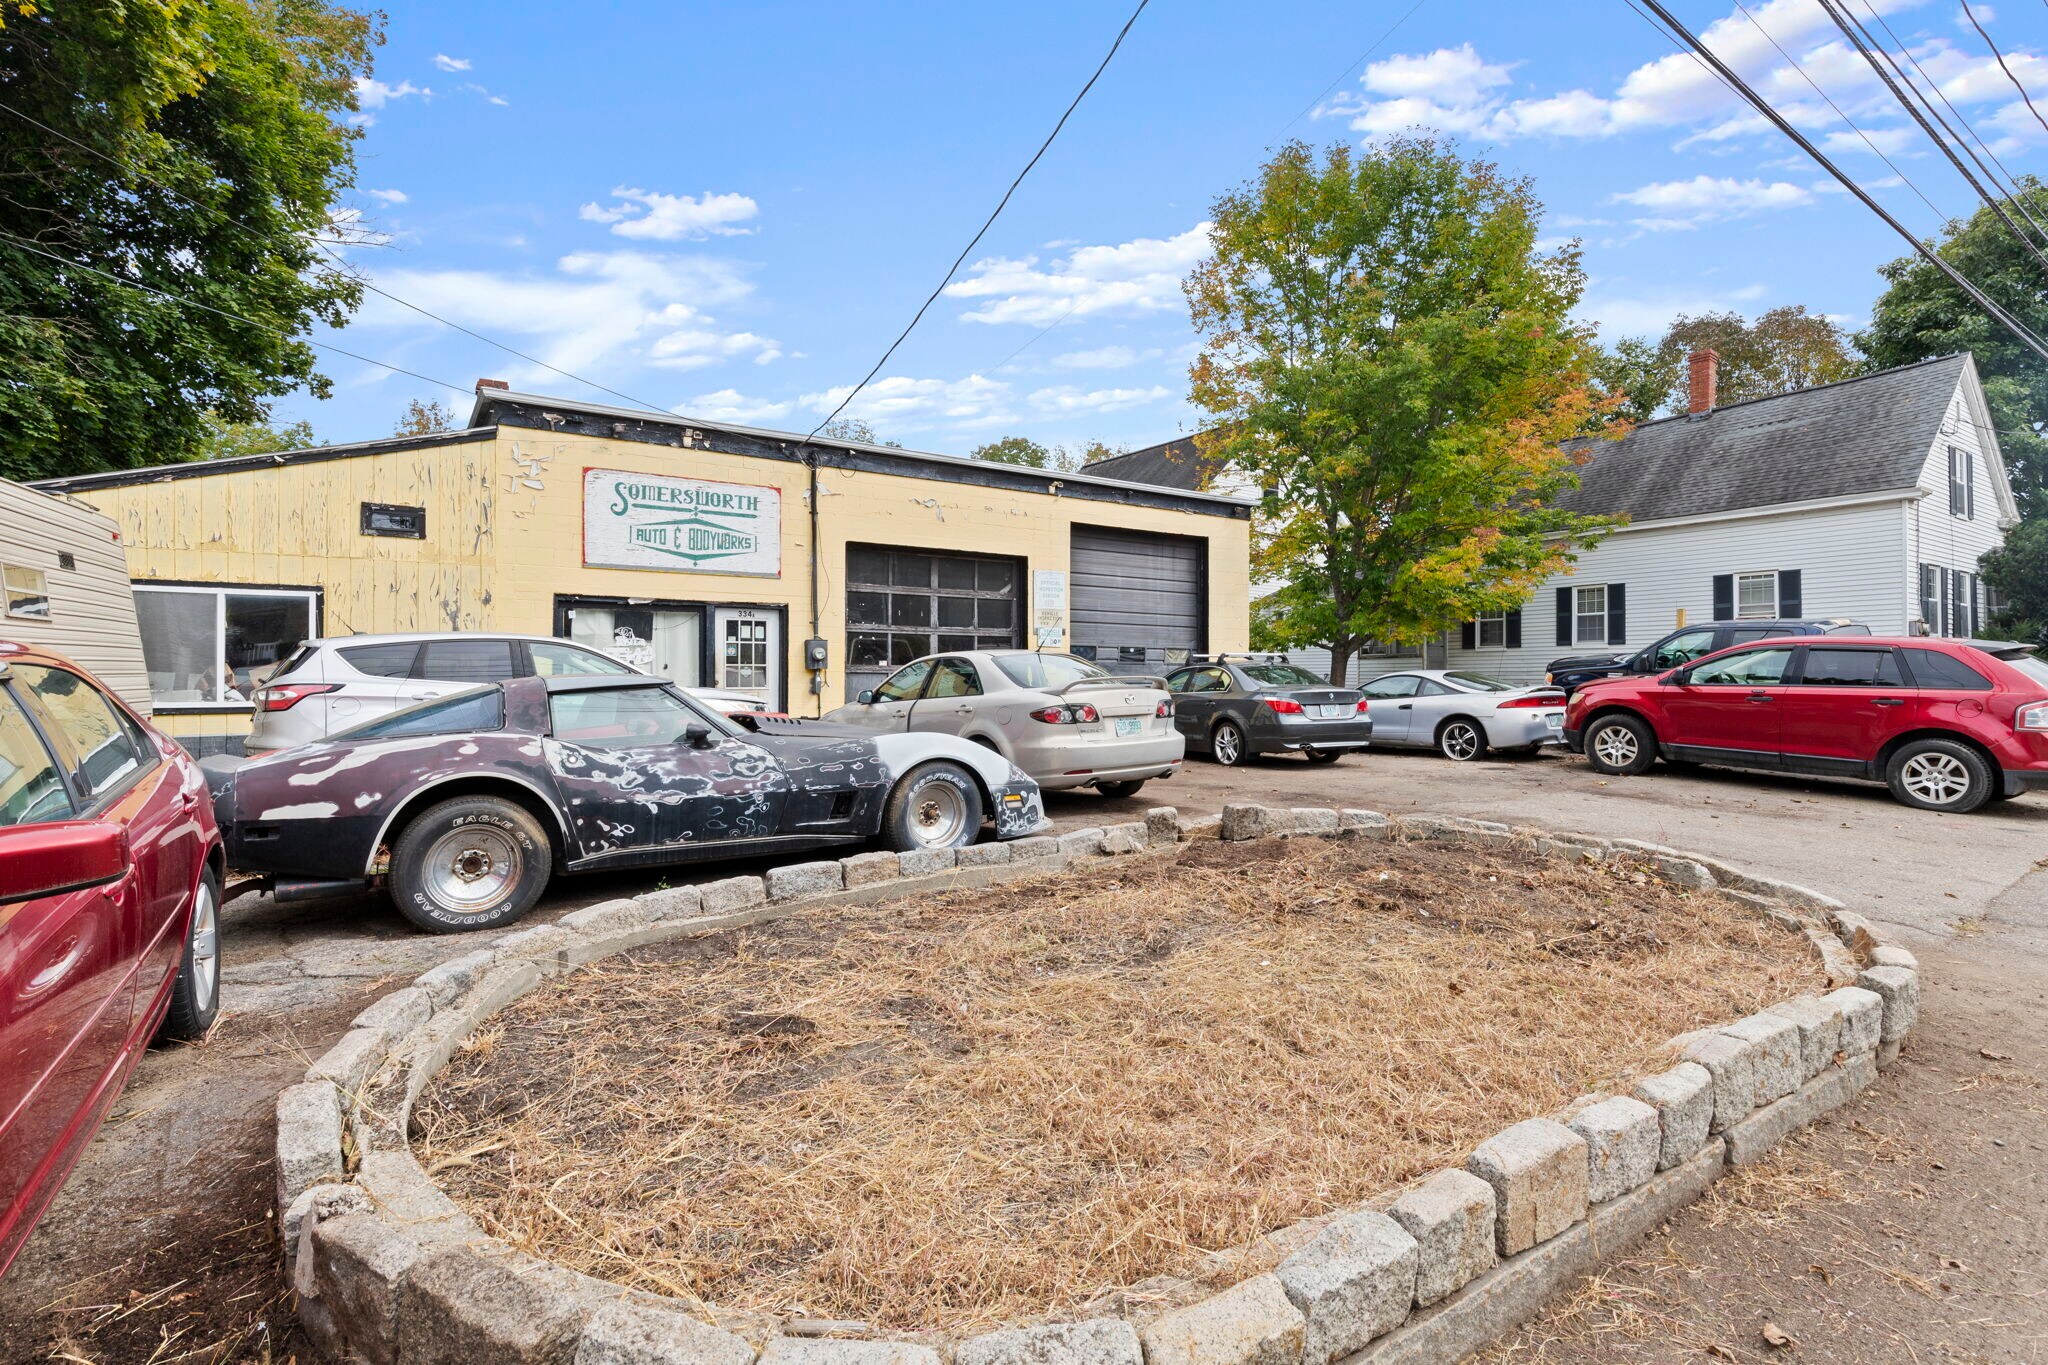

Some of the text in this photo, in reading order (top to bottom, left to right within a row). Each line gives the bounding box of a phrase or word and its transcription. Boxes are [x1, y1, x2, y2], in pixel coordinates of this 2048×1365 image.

[610, 481, 759, 516] SOMERSWORTH
[636, 528, 667, 546] AUTO
[688, 527, 752, 550] BODYWORKS
[908, 773, 966, 800] GOODYEAR
[453, 815, 533, 850] EAGLE GT
[414, 892, 512, 924] GOODYEAR
